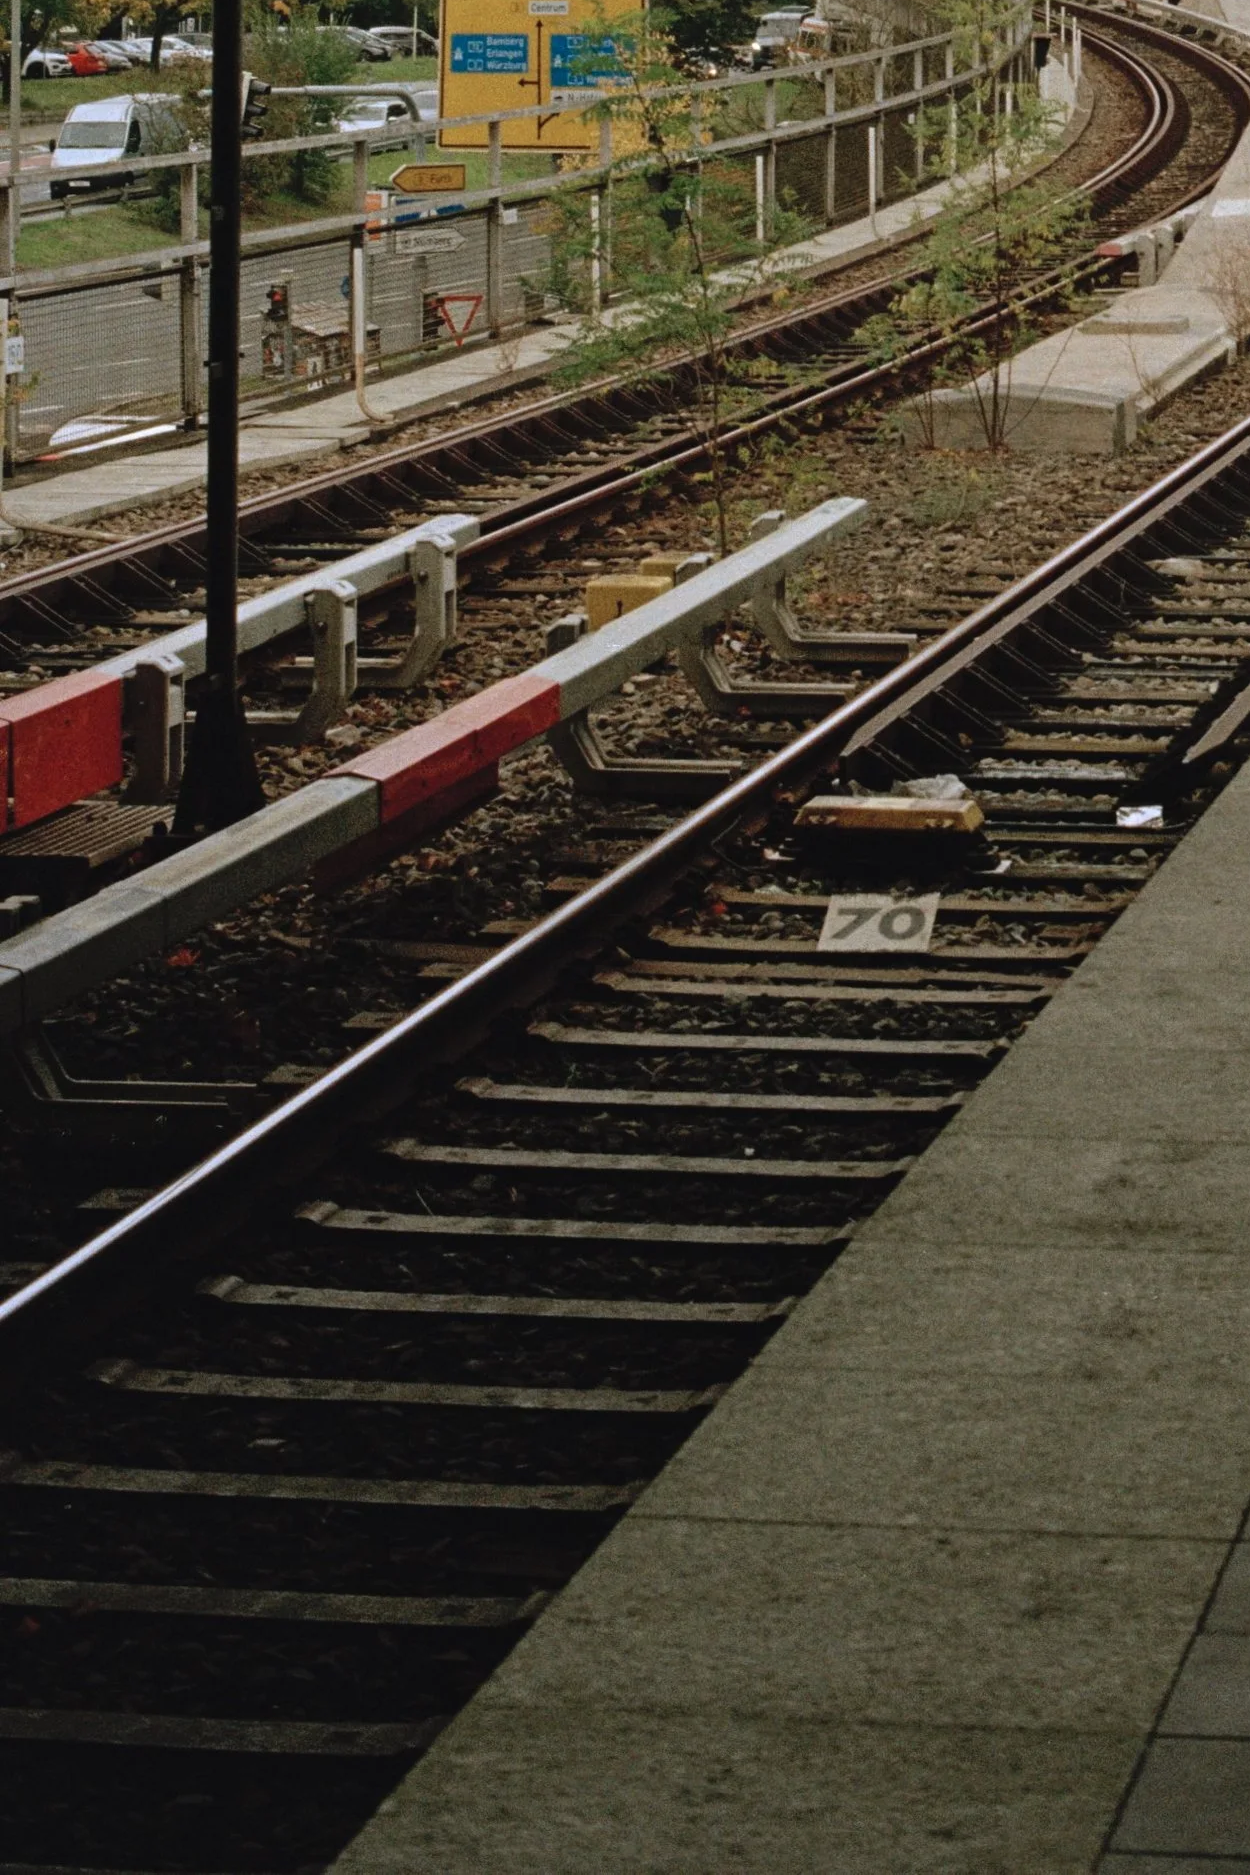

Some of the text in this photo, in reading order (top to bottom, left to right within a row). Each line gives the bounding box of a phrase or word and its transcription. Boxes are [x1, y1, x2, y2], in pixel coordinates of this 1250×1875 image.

[531, 3, 566, 13] Centrum
[486, 36, 524, 48] Bamberg
[486, 49, 523, 60] Erlangen
[486, 60, 527, 71] Würzburg
[830, 905, 926, 940] 70
